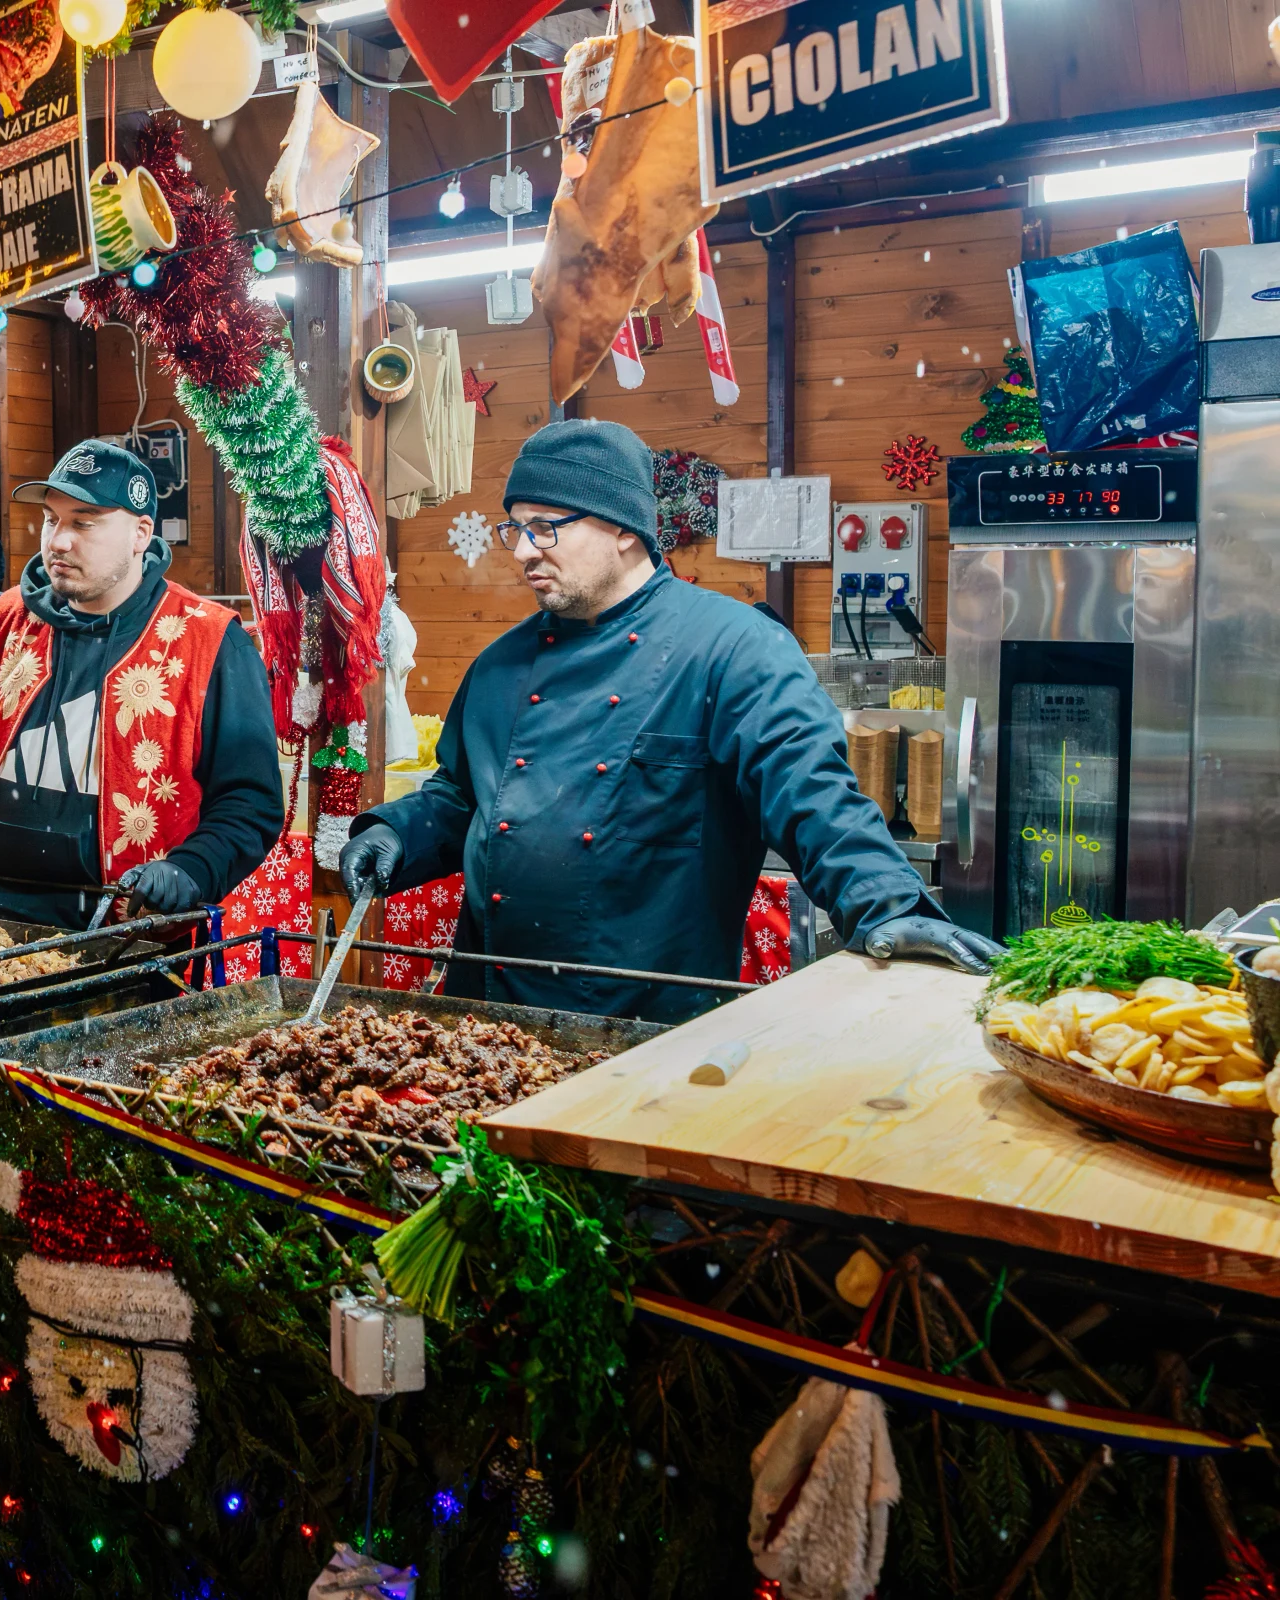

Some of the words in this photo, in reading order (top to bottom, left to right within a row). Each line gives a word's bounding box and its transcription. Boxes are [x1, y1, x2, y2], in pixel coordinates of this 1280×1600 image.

[730, 0, 962, 126] CIOLAN
[1047, 492, 1065, 505] 33
[1078, 491, 1093, 503] 17
[1101, 490, 1120, 503] 90
